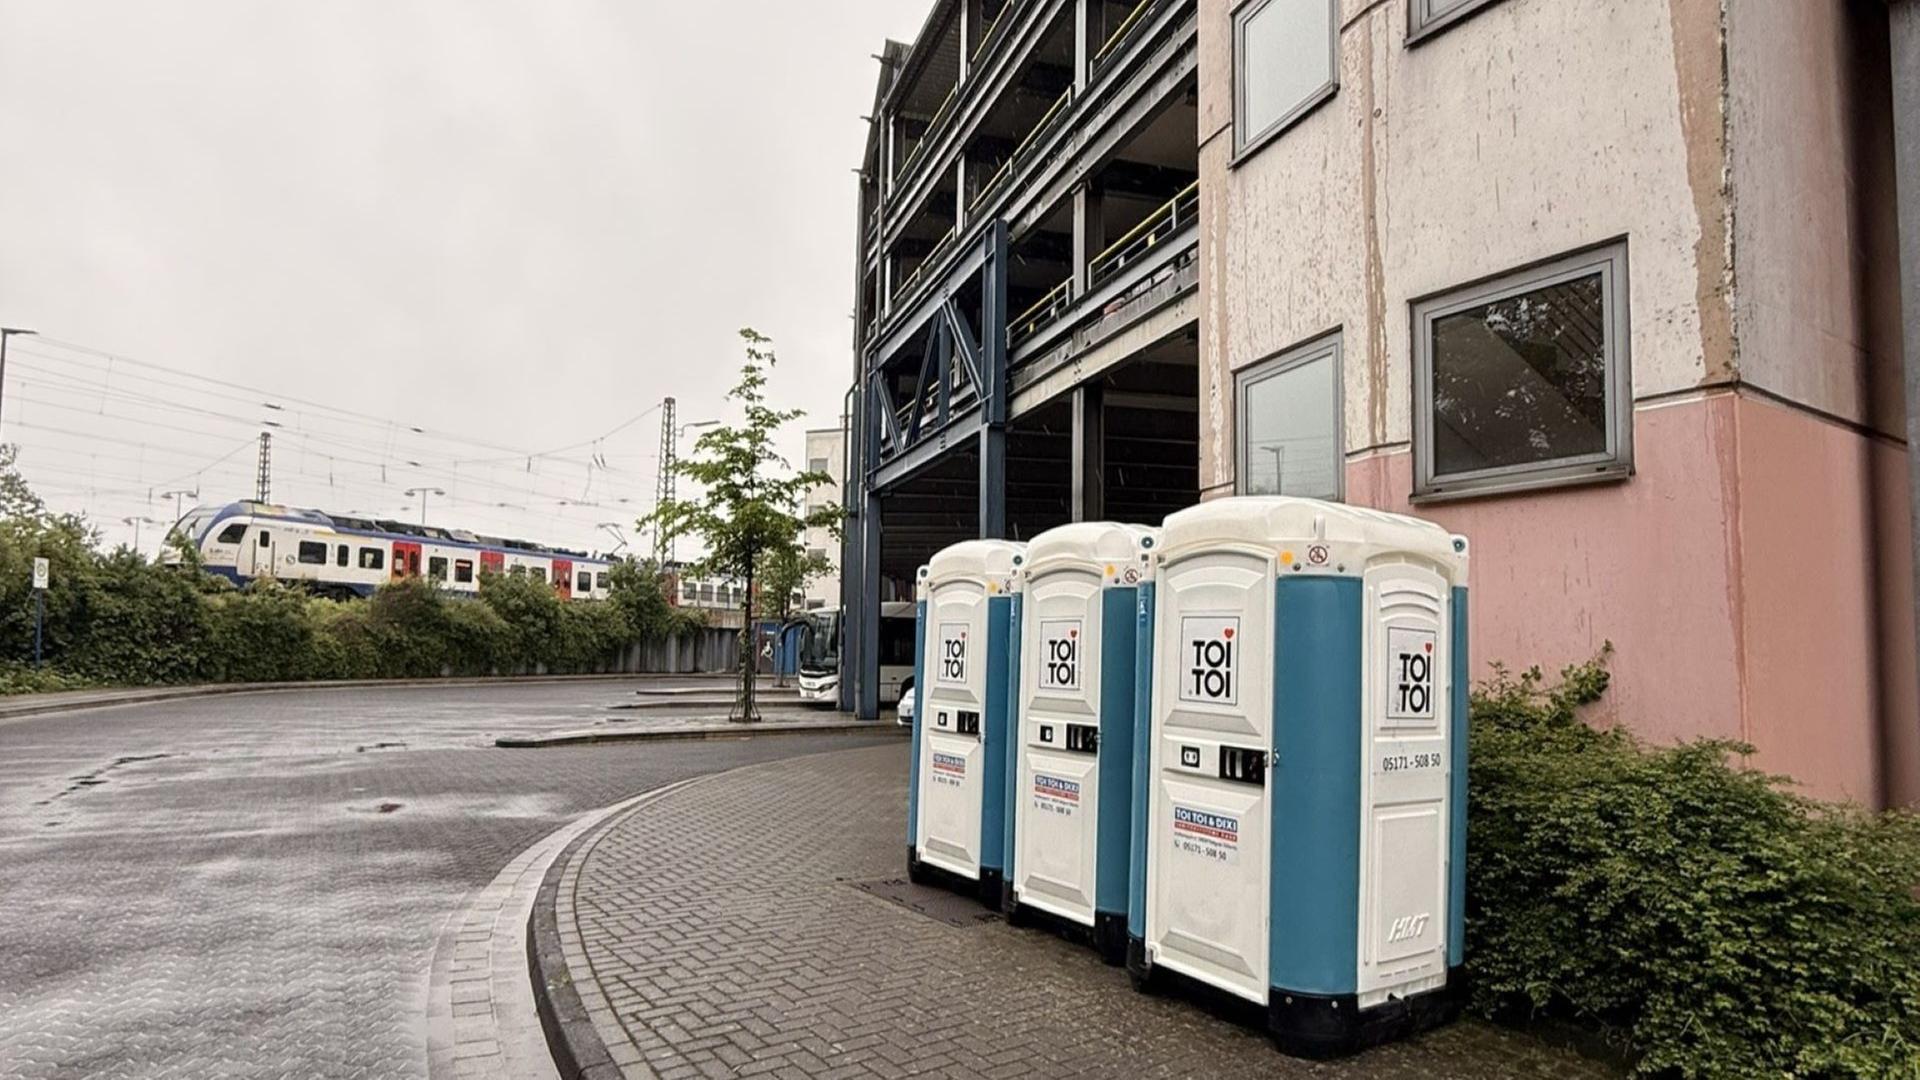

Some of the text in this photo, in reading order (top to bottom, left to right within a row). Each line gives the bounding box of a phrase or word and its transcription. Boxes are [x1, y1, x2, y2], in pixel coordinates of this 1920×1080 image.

[944, 659, 964, 678] TOI
[1047, 662, 1075, 685] TOI
[1191, 669, 1231, 698] TOI
[1399, 684, 1430, 713] TOI
[1176, 809, 1191, 820] TOI
[1192, 812, 1207, 825] TOI
[1215, 817, 1236, 831] DIXI
